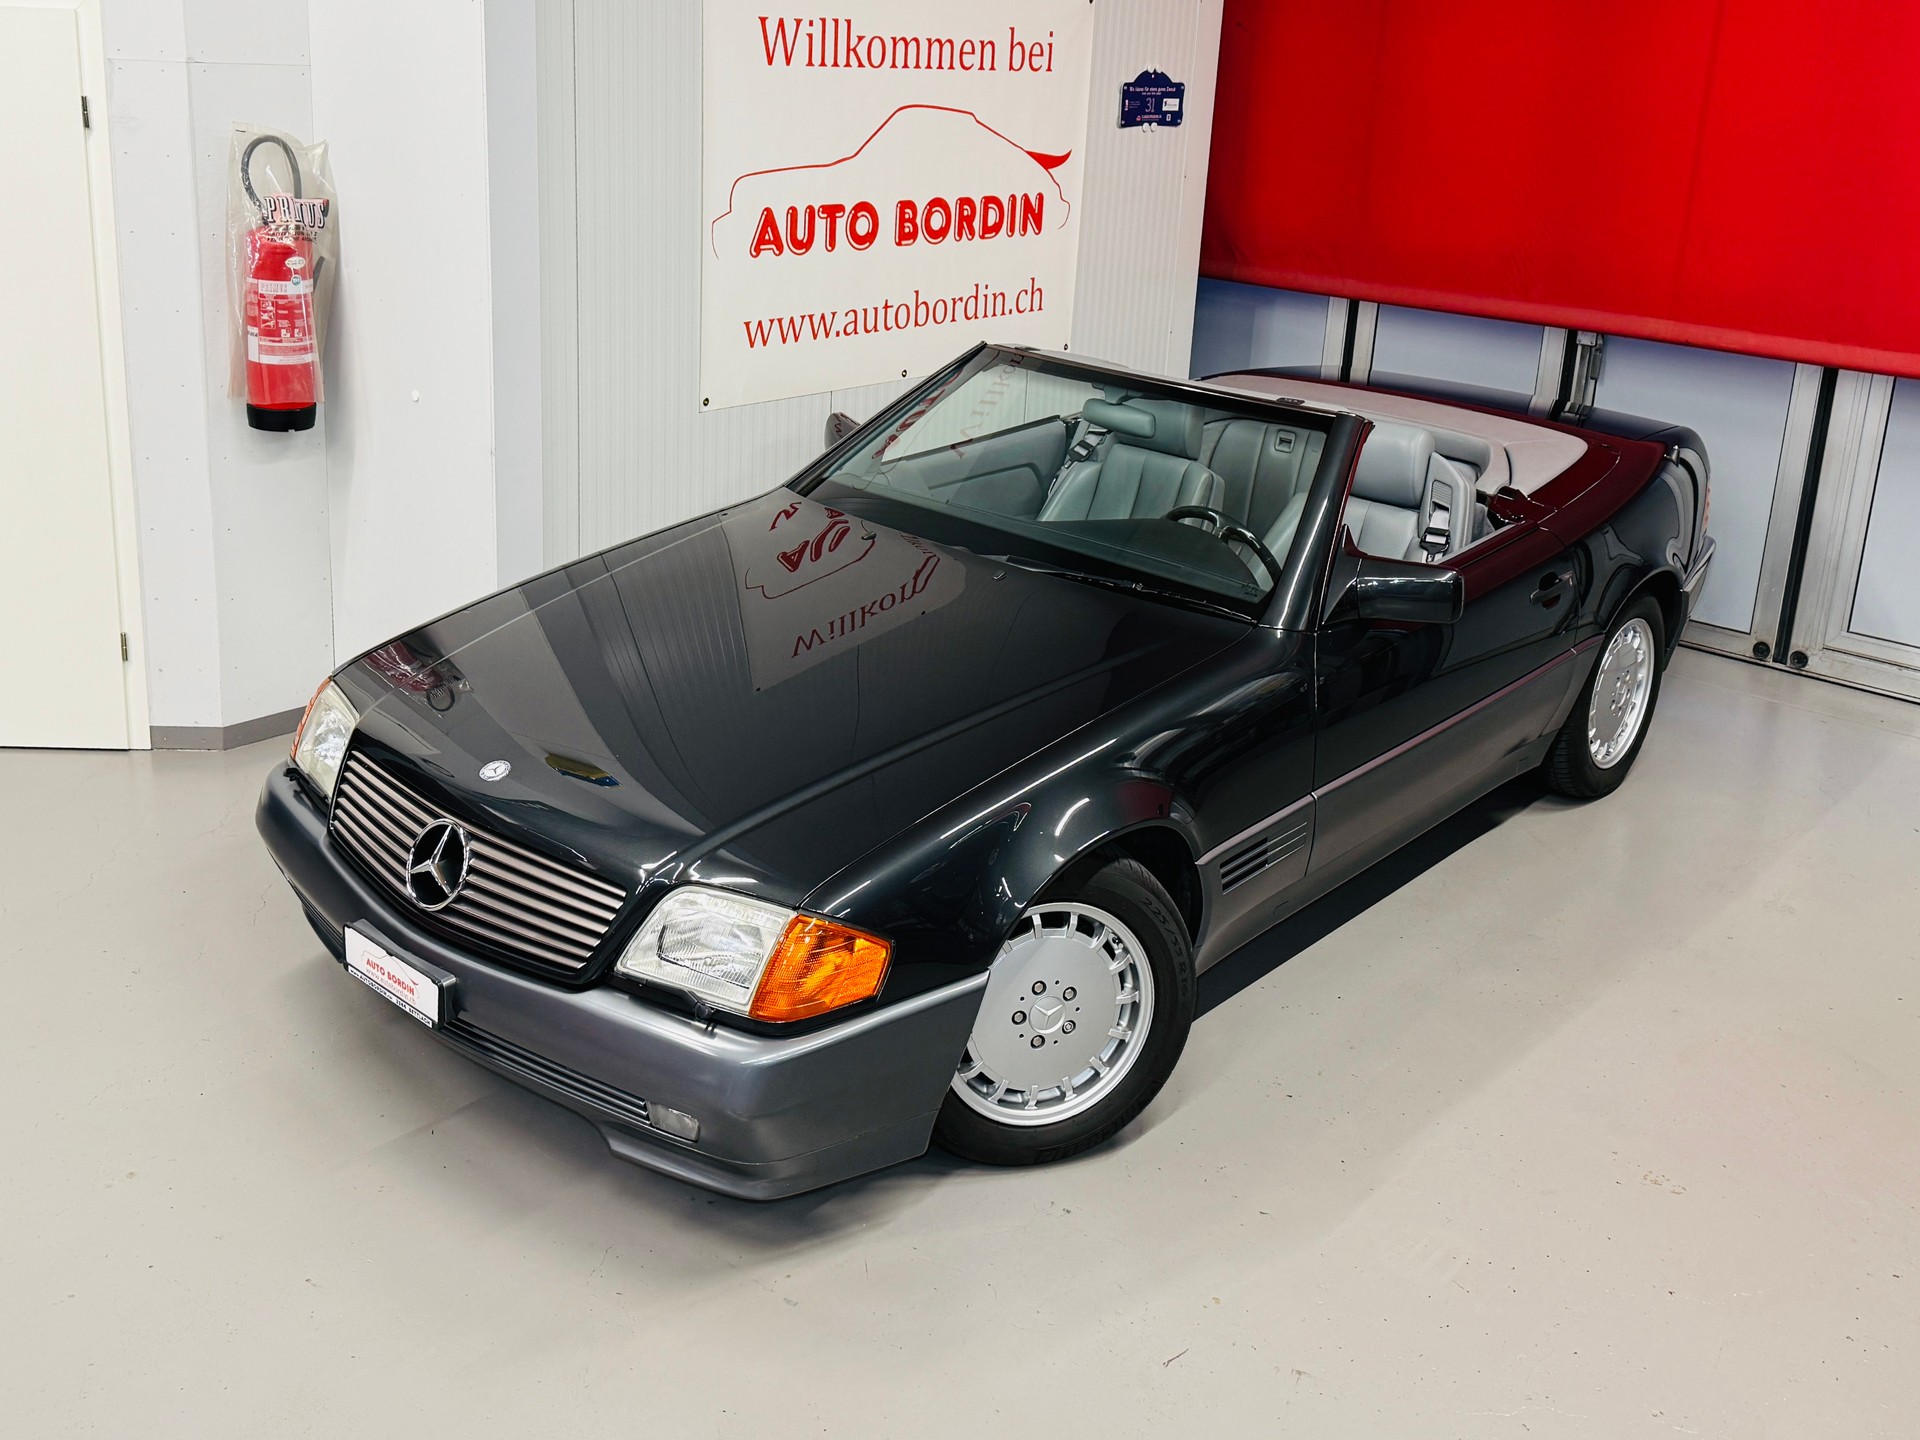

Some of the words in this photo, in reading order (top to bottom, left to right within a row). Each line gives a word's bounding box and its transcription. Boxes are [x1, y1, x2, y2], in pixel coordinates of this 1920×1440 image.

[759, 16, 996, 71] Willkommen
[1009, 26, 1054, 72] bei
[1145, 97, 1155, 113] 31
[750, 201, 880, 259] AUTO
[894, 192, 1044, 247] BORDIN
[744, 277, 1043, 348] www.autobordin.ch
[366, 958, 386, 976] AUTO
[387, 971, 415, 996] BORDIN
